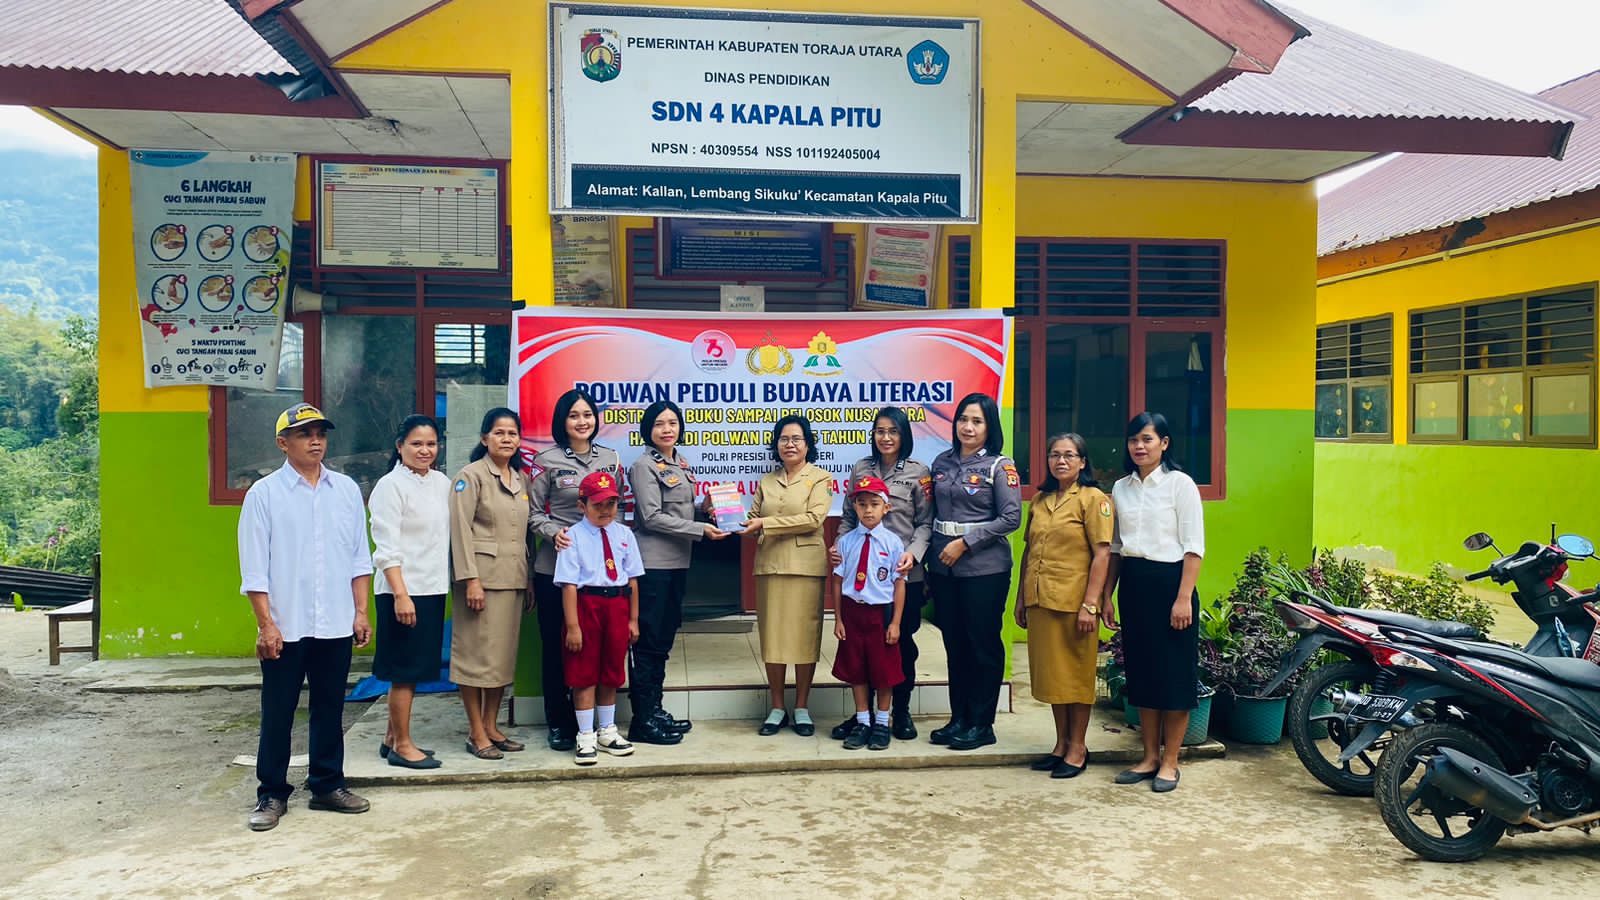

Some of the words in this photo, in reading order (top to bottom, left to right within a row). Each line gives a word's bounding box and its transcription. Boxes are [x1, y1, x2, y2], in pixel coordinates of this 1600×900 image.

[627, 37, 714, 52] PEMERINTAH
[718, 40, 799, 55] KABUPATEN
[802, 43, 855, 57] TORAJA
[859, 45, 903, 58] UTARA
[704, 72, 745, 85] DINAS
[749, 73, 830, 87] PENDIDIKAN
[652, 101, 702, 123] SDN
[709, 102, 725, 124] 4
[731, 103, 824, 127] KAPALA
[831, 106, 881, 129] PITU
[651, 143, 689, 156] NPSN
[700, 144, 759, 158] 40309554
[765, 146, 793, 159] NSS
[796, 146, 881, 161] 101192405004
[181, 180, 190, 192] 6
[193, 180, 252, 193] LANGKAH
[164, 195, 182, 204] CUCI
[183, 196, 215, 204] TANGAN
[216, 196, 238, 205] PAKAI
[239, 196, 266, 205] SABUN
[587, 184, 639, 198] Alamat:
[642, 185, 688, 201] Kallan,
[691, 187, 751, 203] Lembang
[804, 190, 875, 205] Kecamatan
[878, 192, 920, 208] Kapala
[923, 193, 948, 206] Pitu
[678, 382, 756, 403] PEDULI
[763, 382, 851, 403] BUDAYA
[859, 382, 953, 403] LITERASI
[685, 408, 724, 424] BUKU
[727, 408, 778, 424] SAMPAI
[702, 431, 760, 446] POLWAN
[822, 430, 867, 444] TAHUN
[701, 452, 729, 462] POLRI
[731, 452, 766, 462] PRESISI
[738, 465, 772, 475] PEMILU
